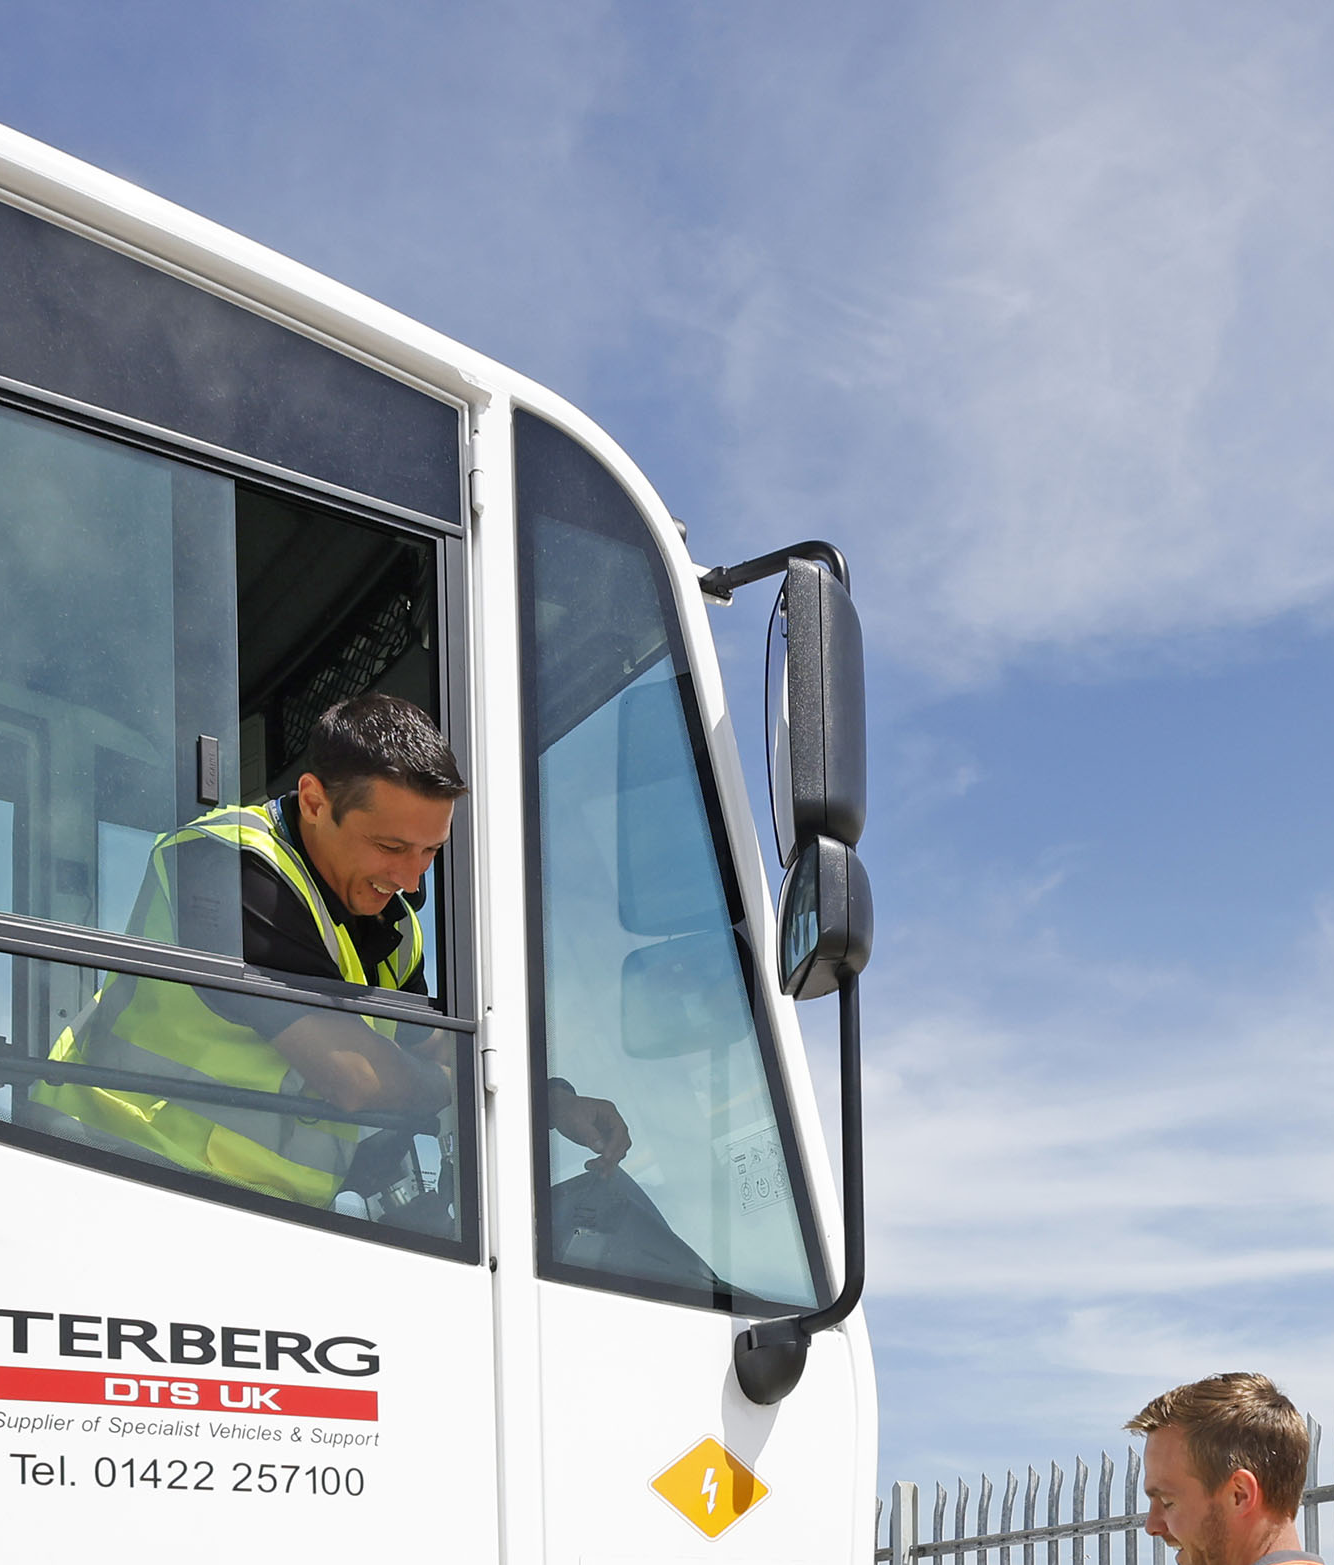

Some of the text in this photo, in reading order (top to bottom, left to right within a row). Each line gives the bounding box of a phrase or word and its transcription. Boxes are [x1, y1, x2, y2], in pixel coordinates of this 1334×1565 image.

[104, 1377, 282, 1411] DTS UK
[81, 1416, 102, 1433] of
[108, 1416, 200, 1440] Specialist
[209, 1422, 284, 1442] Vehicles
[289, 1426, 303, 1443] &
[311, 1428, 381, 1449] Support
[9, 1453, 365, 1497] Tel. 01422 257100
